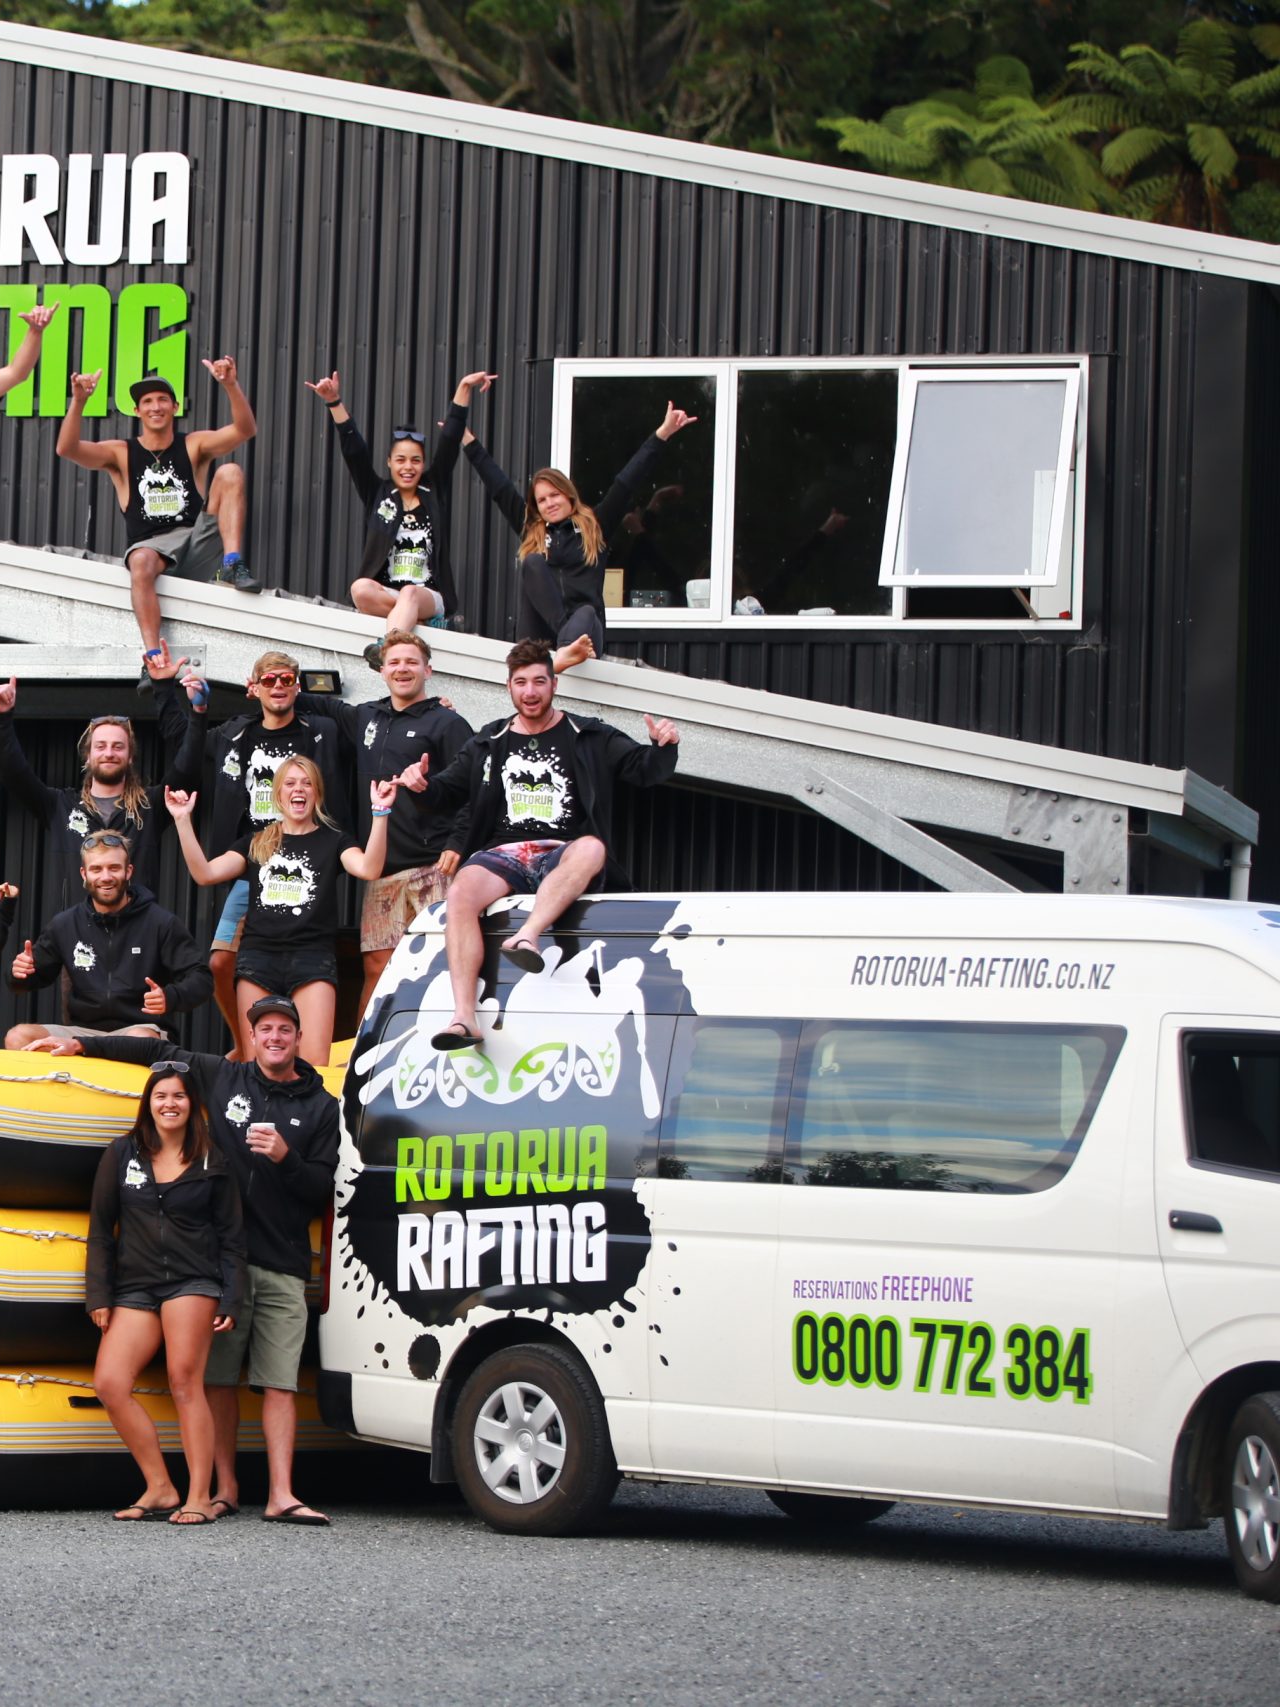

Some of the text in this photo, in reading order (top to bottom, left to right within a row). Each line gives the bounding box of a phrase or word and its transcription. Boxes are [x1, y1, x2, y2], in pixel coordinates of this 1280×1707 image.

[510, 793, 553, 806] ROTORUA
[850, 955, 1116, 991] ROTORUA-RAFTING.CO.NZ
[395, 1125, 608, 1203] ROTORUA
[396, 1201, 608, 1292] RAFTING
[793, 1275, 974, 1302] RESERVATIONS FREEPHONE
[792, 1310, 1093, 1405] 0800 772 384
